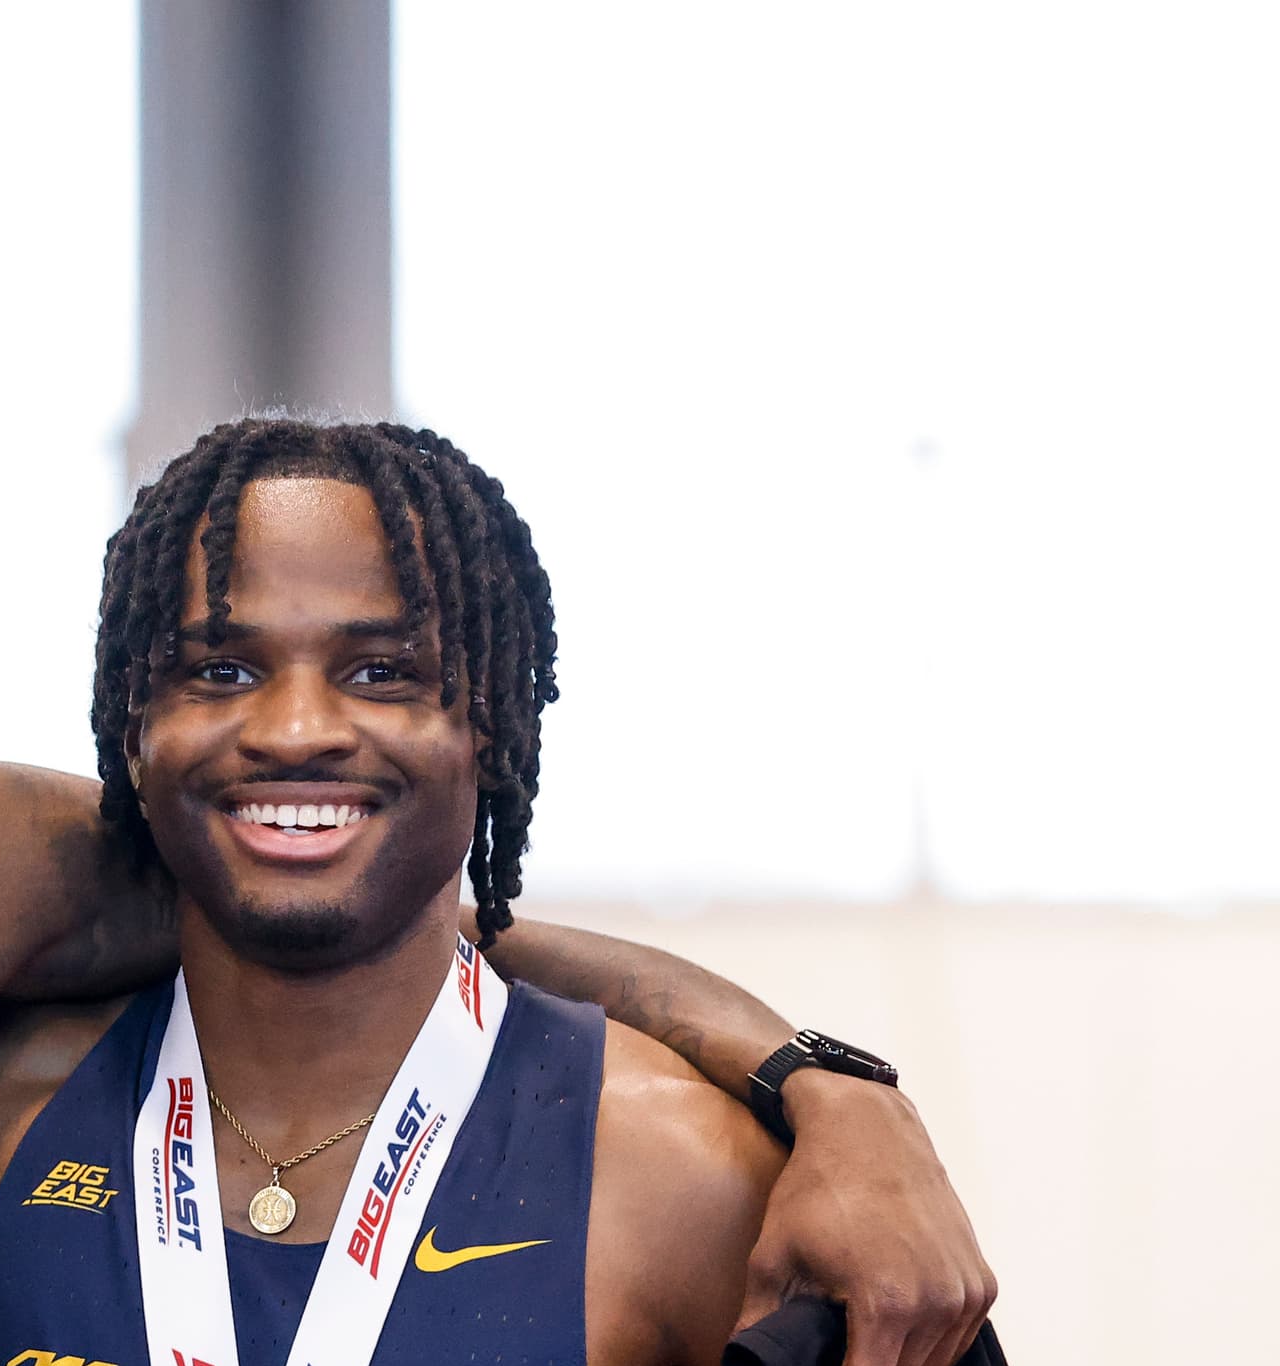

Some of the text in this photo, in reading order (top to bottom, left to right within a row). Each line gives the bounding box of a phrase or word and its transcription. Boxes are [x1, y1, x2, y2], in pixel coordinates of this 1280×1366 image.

[47, 1160, 110, 1186] BIG
[404, 1114, 447, 1195] CONFERENCE
[31, 1179, 119, 1208] EAST
[152, 1148, 166, 1245] CONFERENCE
